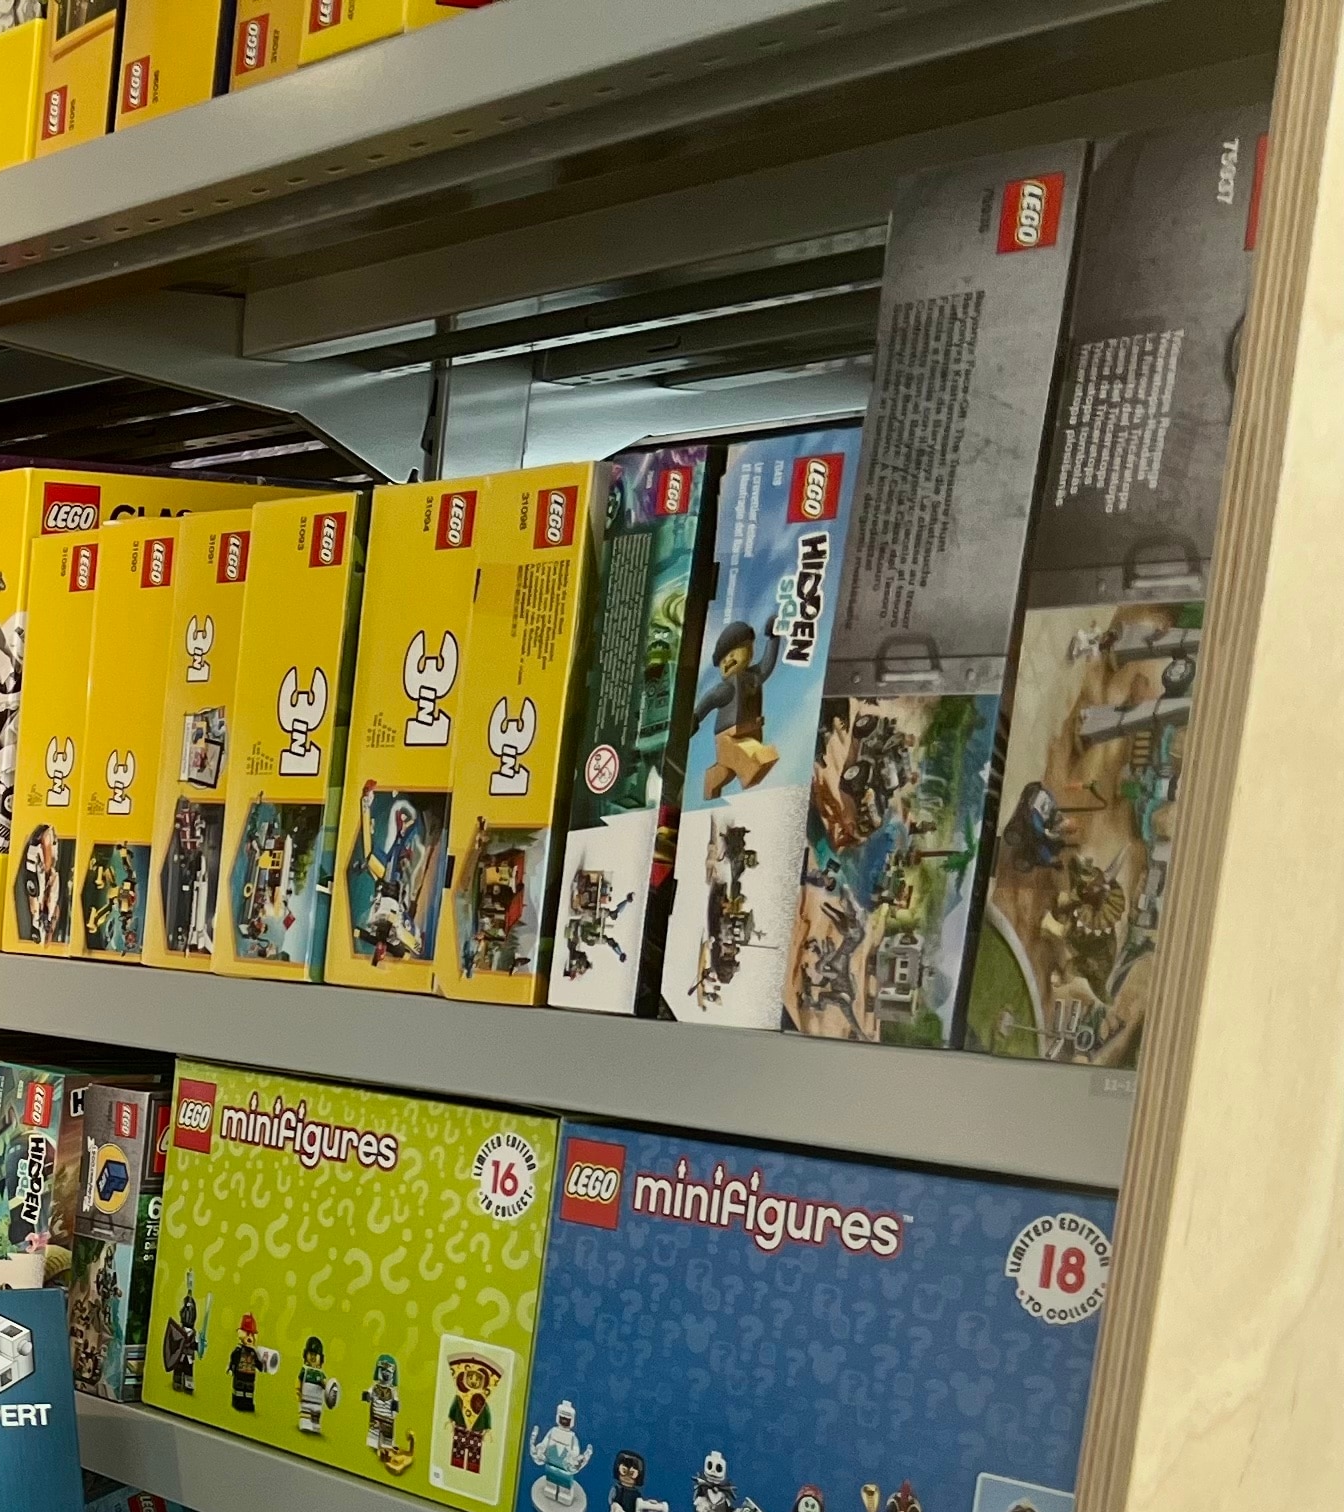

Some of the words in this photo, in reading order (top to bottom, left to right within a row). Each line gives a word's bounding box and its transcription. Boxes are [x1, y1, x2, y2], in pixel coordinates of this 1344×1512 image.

[244, 21, 259, 68] LEGO
[128, 60, 142, 107] LEGO
[47, 90, 60, 135] LEGO
[1014, 182, 1044, 245] LEGO
[666, 470, 683, 511] LEGO
[805, 461, 826, 517] LEGO
[47, 503, 95, 531] LEGO
[297, 516, 308, 551] 31093
[423, 497, 434, 533] 31094
[449, 496, 466, 546] LEGO
[519, 493, 529, 531] 31098
[546, 495, 566, 544] LEGO
[226, 535, 243, 579] LEGO
[319, 516, 338, 562] LEGO
[77, 548, 92, 589] LEGO
[151, 542, 167, 586] LEGO
[774, 577, 798, 634] SIDE
[786, 533, 828, 665] HIDDEN
[403, 630, 459, 702] 3
[277, 666, 329, 736] 3
[415, 687, 438, 725] IN
[289, 721, 309, 756] IN
[404, 717, 451, 747] 1
[489, 696, 537, 756] 3
[279, 748, 321, 777] 1
[489, 766, 531, 796] 1
[496, 745, 518, 777] IN
[32, 1084, 46, 1125] LEGO
[121, 1104, 132, 1137] LEGO
[179, 1101, 212, 1132] LEGO
[220, 1090, 399, 1170] minifigures
[473, 1136, 502, 1177] LIMITED
[506, 1134, 537, 1171] EDITION
[17, 1159, 29, 1198] SIDE
[22, 1136, 46, 1224] HIDDEN
[492, 1160, 519, 1197] 16
[567, 1165, 620, 1203] LEGO
[481, 1195, 493, 1211] TO
[495, 1189, 533, 1217] COLLECT
[633, 1158, 901, 1255] minifigures
[1011, 1217, 1053, 1274] LIMITED
[1059, 1216, 1110, 1269] EDITION
[1039, 1244, 1087, 1294] 18
[1025, 1295, 1043, 1315] TO
[1047, 1287, 1105, 1321] COLLECT
